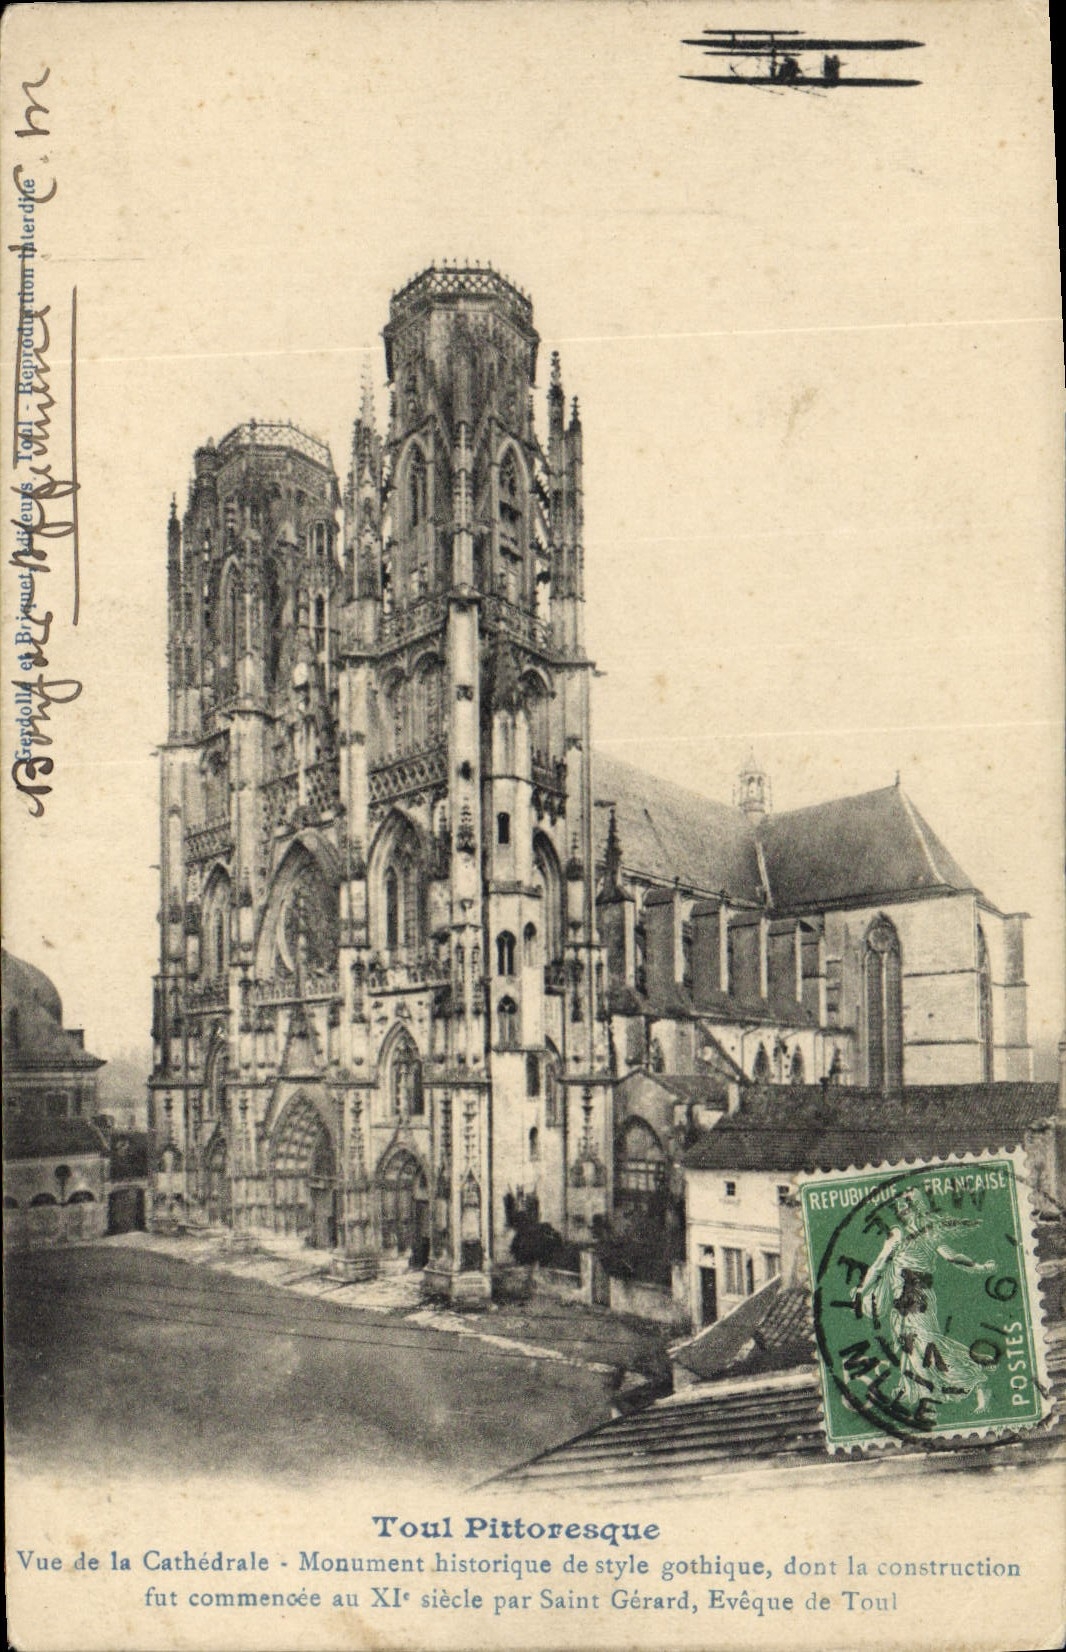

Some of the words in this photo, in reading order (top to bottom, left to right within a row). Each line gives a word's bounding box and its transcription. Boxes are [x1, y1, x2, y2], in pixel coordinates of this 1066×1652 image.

[1004, 1321, 1031, 1407] POSTES
[371, 1515, 453, 1540] Toul
[463, 1516, 660, 1546] Pittoresque
[16, 1549, 63, 1573] Vue
[73, 1551, 100, 1573] de
[109, 1549, 131, 1572] la
[141, 1549, 270, 1573] Cathédrale
[298, 1551, 424, 1574] Monument
[435, 1552, 553, 1581] historique
[561, 1553, 588, 1575] de
[594, 1554, 649, 1581] style
[660, 1554, 773, 1582] gothique,
[783, 1555, 836, 1577] dont
[848, 1556, 874, 1577] la
[877, 1557, 1021, 1578] construction
[144, 1586, 177, 1608] fut
[187, 1586, 321, 1609] commencée
[331, 1593, 359, 1609] au
[420, 1587, 483, 1610] siècle
[492, 1594, 532, 1616] par
[539, 1588, 599, 1611] Saint
[610, 1588, 698, 1614] Gérard,
[708, 1588, 794, 1617] Evêque
[805, 1589, 831, 1611] de
[841, 1589, 897, 1612] Toul
